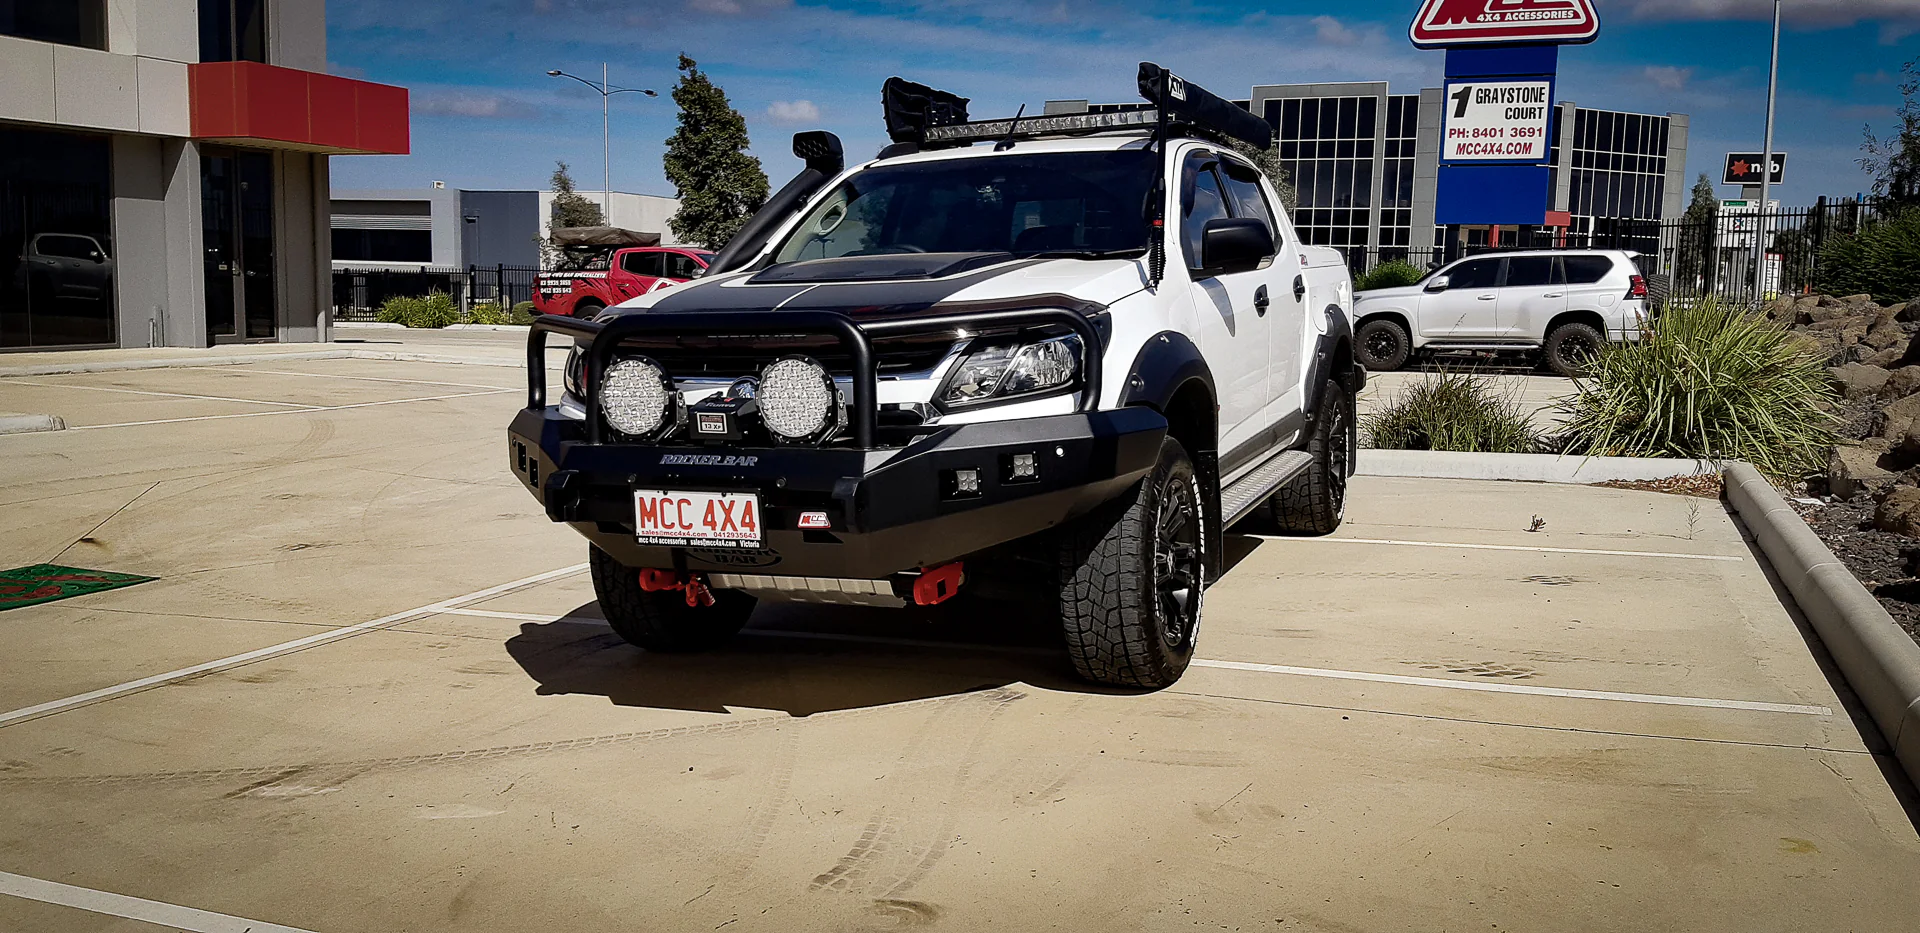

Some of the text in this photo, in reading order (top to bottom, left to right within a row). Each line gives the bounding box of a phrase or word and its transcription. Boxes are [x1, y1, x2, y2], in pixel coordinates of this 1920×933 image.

[1477, 10, 1574, 22] 4X4 ACCESSORIES
[1450, 86, 1546, 118] 1 GRAYSTONE
[1504, 106, 1545, 120] COURT
[1448, 126, 1543, 138] PH: 8401 3691
[1455, 142, 1533, 155] MCC4X4.COM
[659, 454, 759, 467] ROCKER BAR
[639, 496, 756, 533] MCC 4X4
[658, 536, 688, 546] accessories
[739, 540, 760, 548] Victoria
